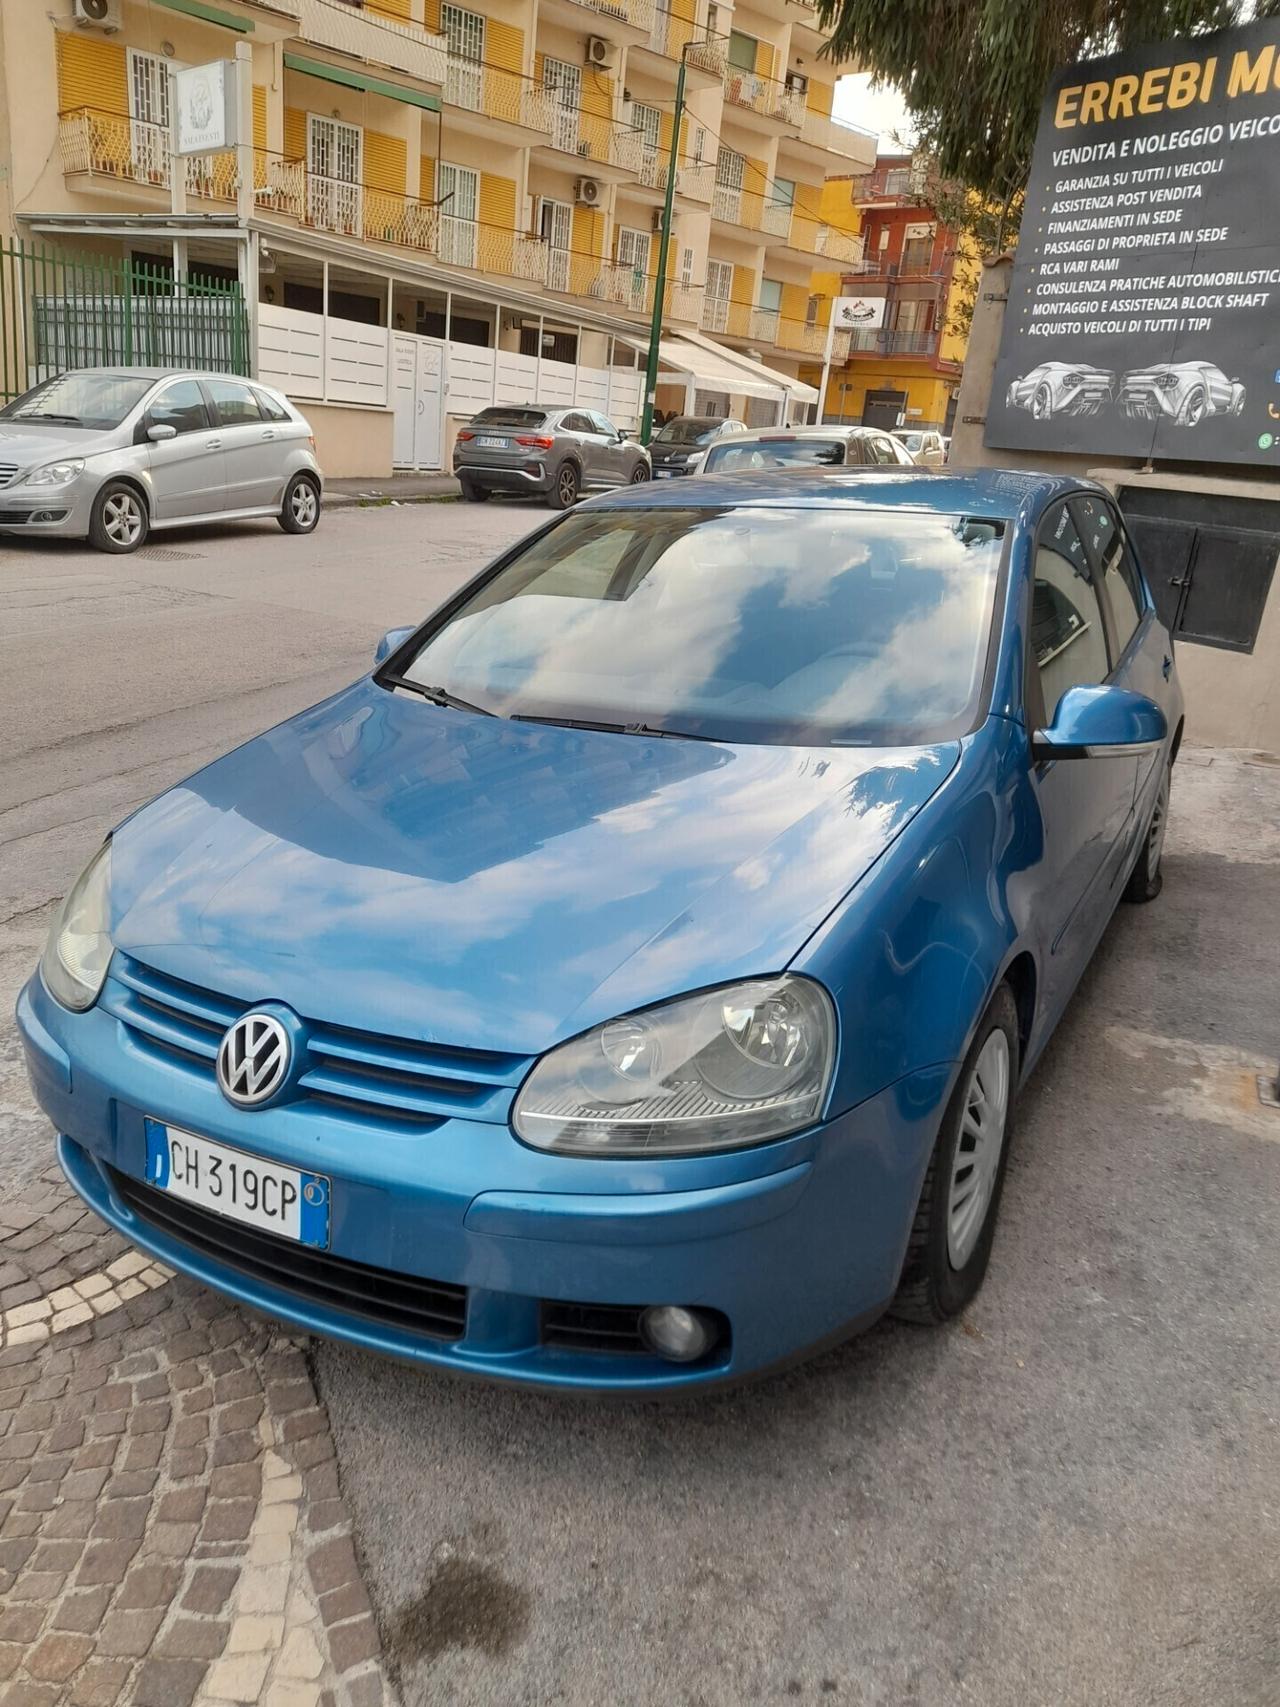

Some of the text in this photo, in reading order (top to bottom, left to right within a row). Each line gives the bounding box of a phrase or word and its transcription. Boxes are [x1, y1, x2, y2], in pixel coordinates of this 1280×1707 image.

[1054, 45, 1280, 128] ERREBI M
[1052, 142, 1116, 167] VENDITA
[1120, 140, 1130, 157] E
[1133, 124, 1223, 155] NOLEGGIO
[1055, 174, 1110, 193] GARANZIA
[1112, 172, 1128, 186] SU
[1131, 167, 1164, 183] TUTTI
[1174, 159, 1224, 178] VEICOLI
[1051, 184, 1202, 214] ASSISTENZA POST VENDITA
[1047, 209, 1183, 235] FINANZIAMENTI IN SEDE
[1043, 227, 1229, 255] PASSAGGI DI PROPRIETA IN SEDE
[1040, 258, 1120, 276] RCA VARI RAMI
[1036, 280, 1107, 296] CONSULENZA
[1109, 276, 1166, 291] PRATICHE
[1032, 293, 1269, 316] MONTAGGIO E ASSISTENZA BLOCK SHAFT
[1028, 322, 1082, 337] ACQUISTO
[1083, 321, 1126, 334] VEICOLI
[1128, 320, 1142, 332] DI
[1144, 319, 1178, 332] TUTTI
[1187, 318, 1212, 331] TIPI
